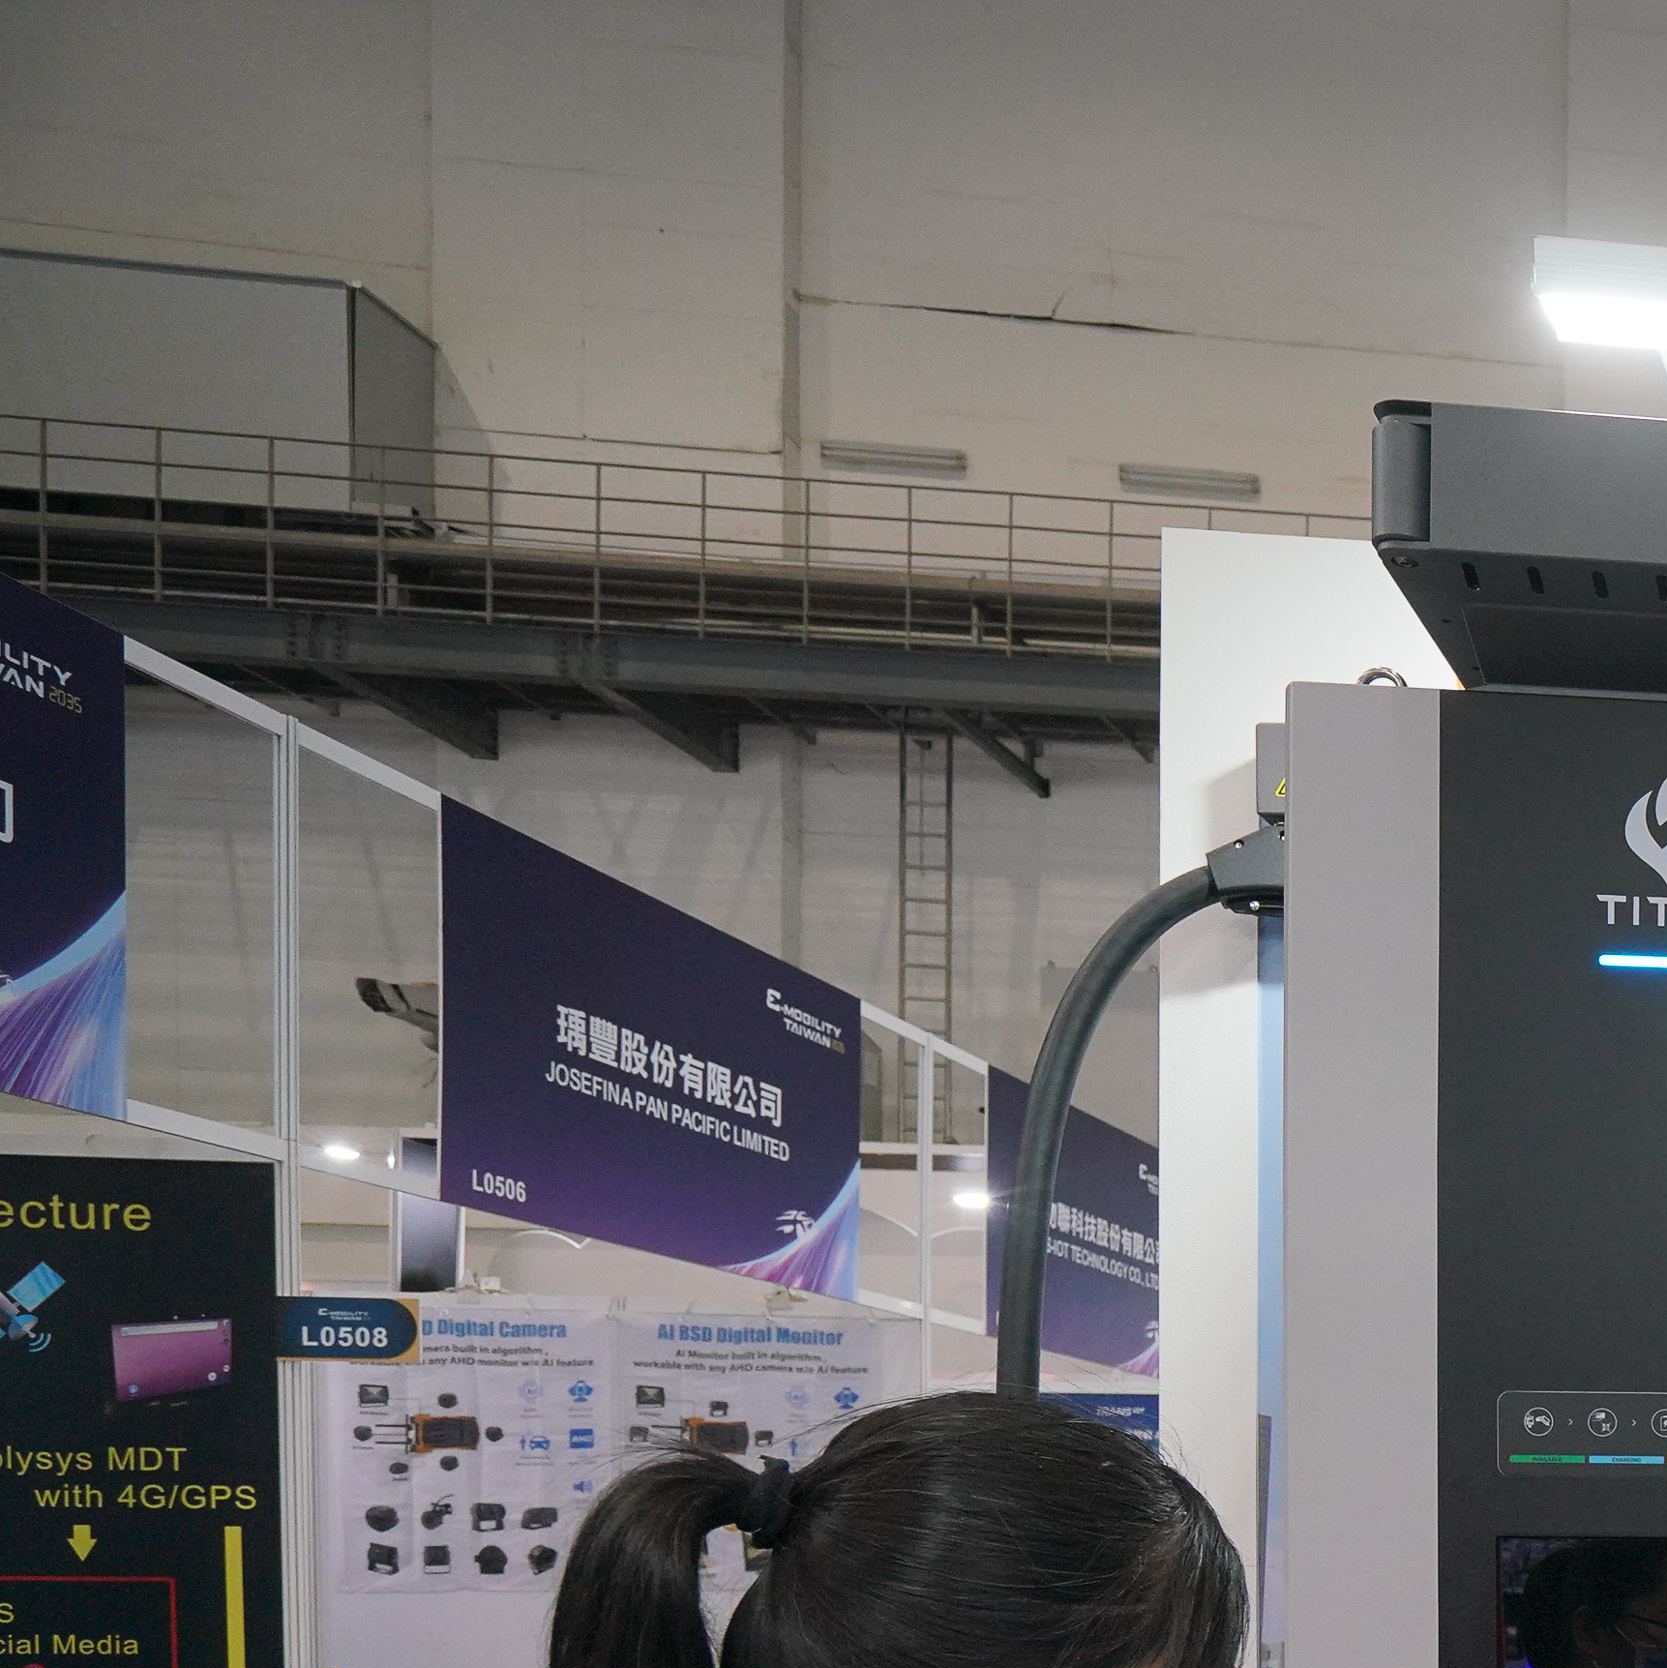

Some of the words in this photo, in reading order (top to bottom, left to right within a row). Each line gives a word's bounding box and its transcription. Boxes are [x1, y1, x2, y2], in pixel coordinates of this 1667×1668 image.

[0, 637, 73, 687] LITY
[49, 685, 84, 715] 2035
[783, 1017, 832, 1049] TAIWAN
[545, 1060, 634, 1110] JOSEFINA
[636, 1092, 669, 1122] PAN
[672, 1103, 731, 1144] PACIFIC
[733, 1127, 790, 1163] LIMITED
[472, 1168, 527, 1203] L0506
[301, 1326, 388, 1348] L0508
[438, 1319, 495, 1338] Digital
[499, 1321, 568, 1339] Camera
[679, 1324, 712, 1342] BSD
[716, 1326, 772, 1345] Digital
[776, 1328, 843, 1346] Monitor
[0, 1445, 93, 1477] lysys
[107, 1447, 188, 1472] MDT
[34, 1484, 104, 1509] with
[118, 1484, 257, 1510] 4G/GPS
[53, 1634, 139, 1655] Media
